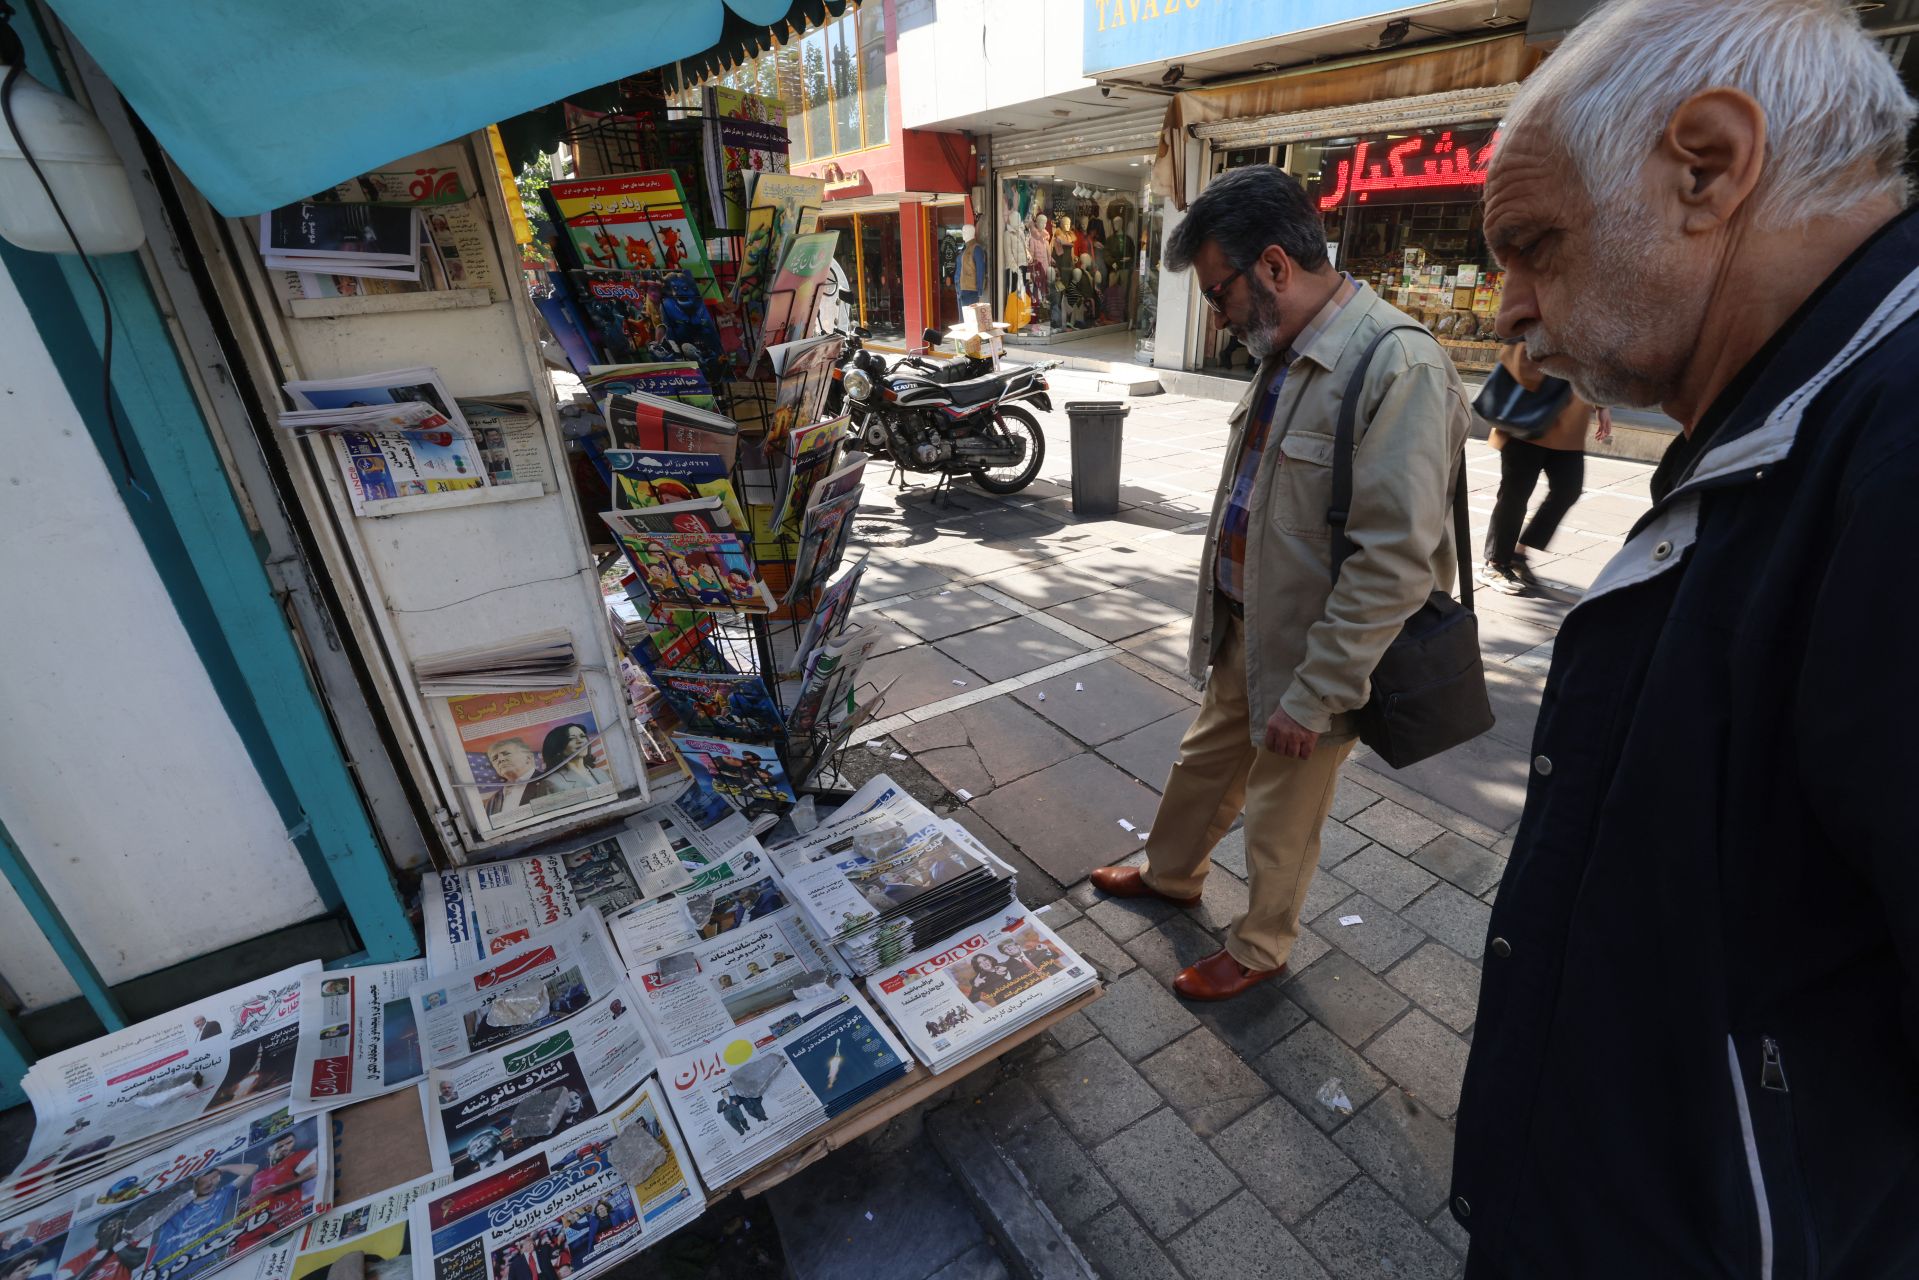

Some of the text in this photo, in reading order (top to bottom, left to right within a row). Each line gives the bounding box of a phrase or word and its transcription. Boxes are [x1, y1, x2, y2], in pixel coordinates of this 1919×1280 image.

[1095, 0, 1200, 32] TAVA
[605, 201, 618, 213] بی
[620, 194, 646, 211] روباه
[659, 379, 668, 388] در
[670, 377, 699, 387] حیوانات
[803, 833, 832, 849] انتخابات
[447, 902, 470, 944] صنعت
[750, 930, 772, 946] رقابت
[477, 945, 552, 990] شرق
[792, 1047, 807, 1058] فضا
[157, 1063, 182, 1078] دولت
[518, 1061, 563, 1090] ائتلاف
[674, 1052, 726, 1090] ایران
[461, 1082, 516, 1116] نانوشته
[597, 1170, 618, 1184] ۲۴۰
[564, 1182, 598, 1202] میلیارد
[487, 1180, 554, 1228] صبح
[543, 1197, 564, 1215] برای
[192, 1208, 270, 1261] فاجعه
